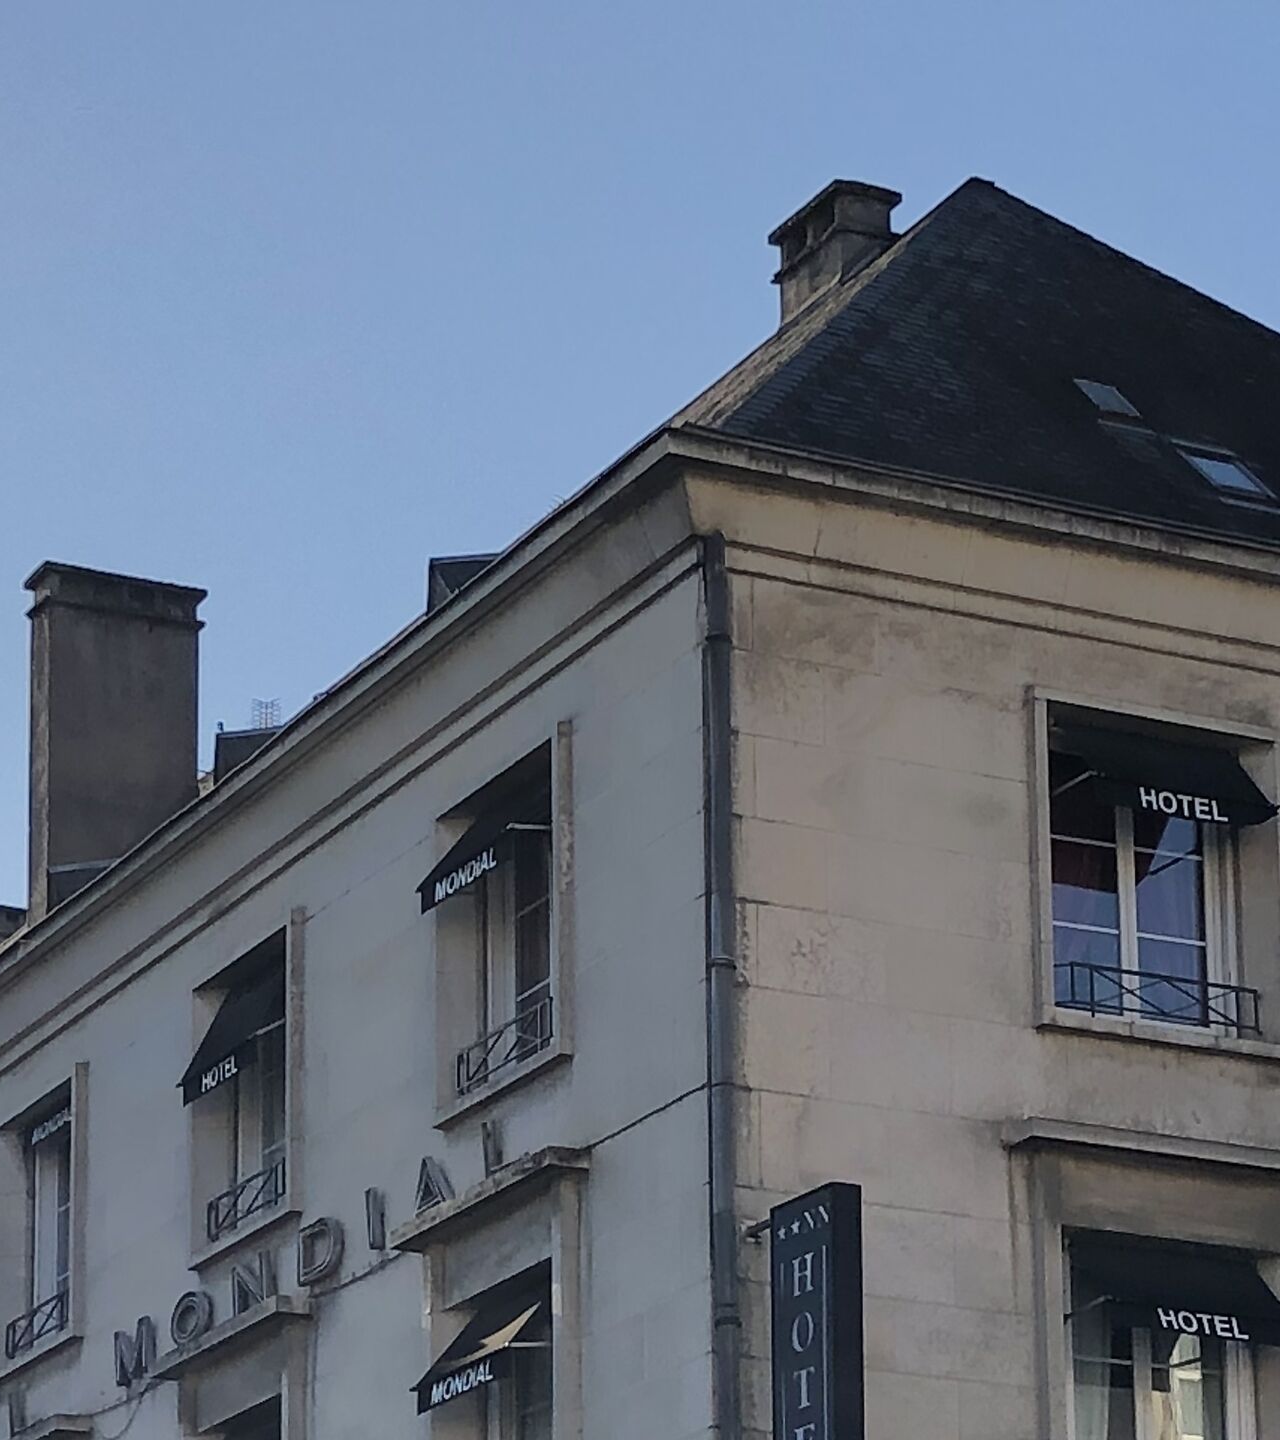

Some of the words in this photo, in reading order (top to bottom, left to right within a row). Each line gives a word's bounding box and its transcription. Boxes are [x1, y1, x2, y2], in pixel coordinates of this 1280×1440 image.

[1139, 785, 1229, 822] HOTEL
[434, 847, 497, 903] MONDIAL
[201, 1054, 238, 1094] HOTEL
[1156, 1306, 1250, 1341] HOTEL
[429, 1359, 494, 1406] MONDIAL
